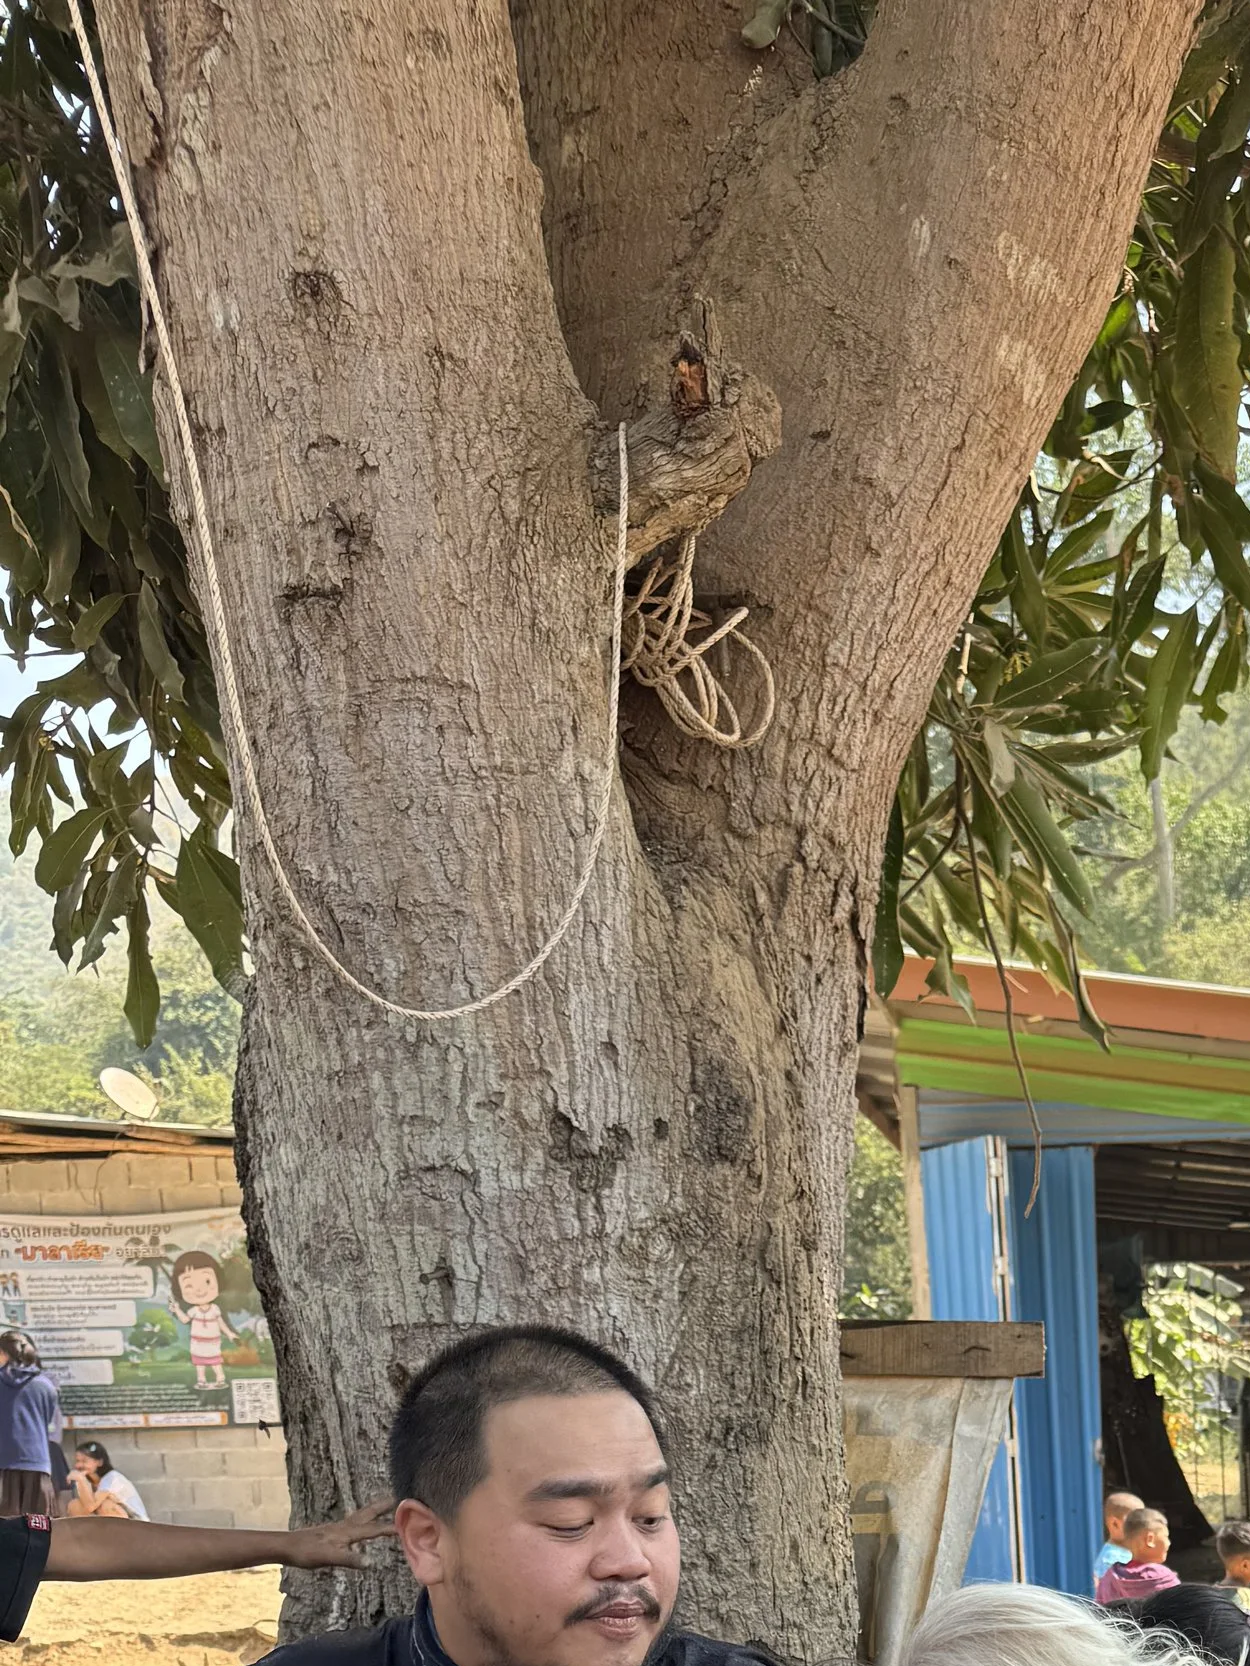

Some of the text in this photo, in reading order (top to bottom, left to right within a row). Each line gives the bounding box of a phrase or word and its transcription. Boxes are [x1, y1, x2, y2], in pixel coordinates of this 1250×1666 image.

[0, 1222, 171, 1242] รดูแลและป้องกันตนเอง
